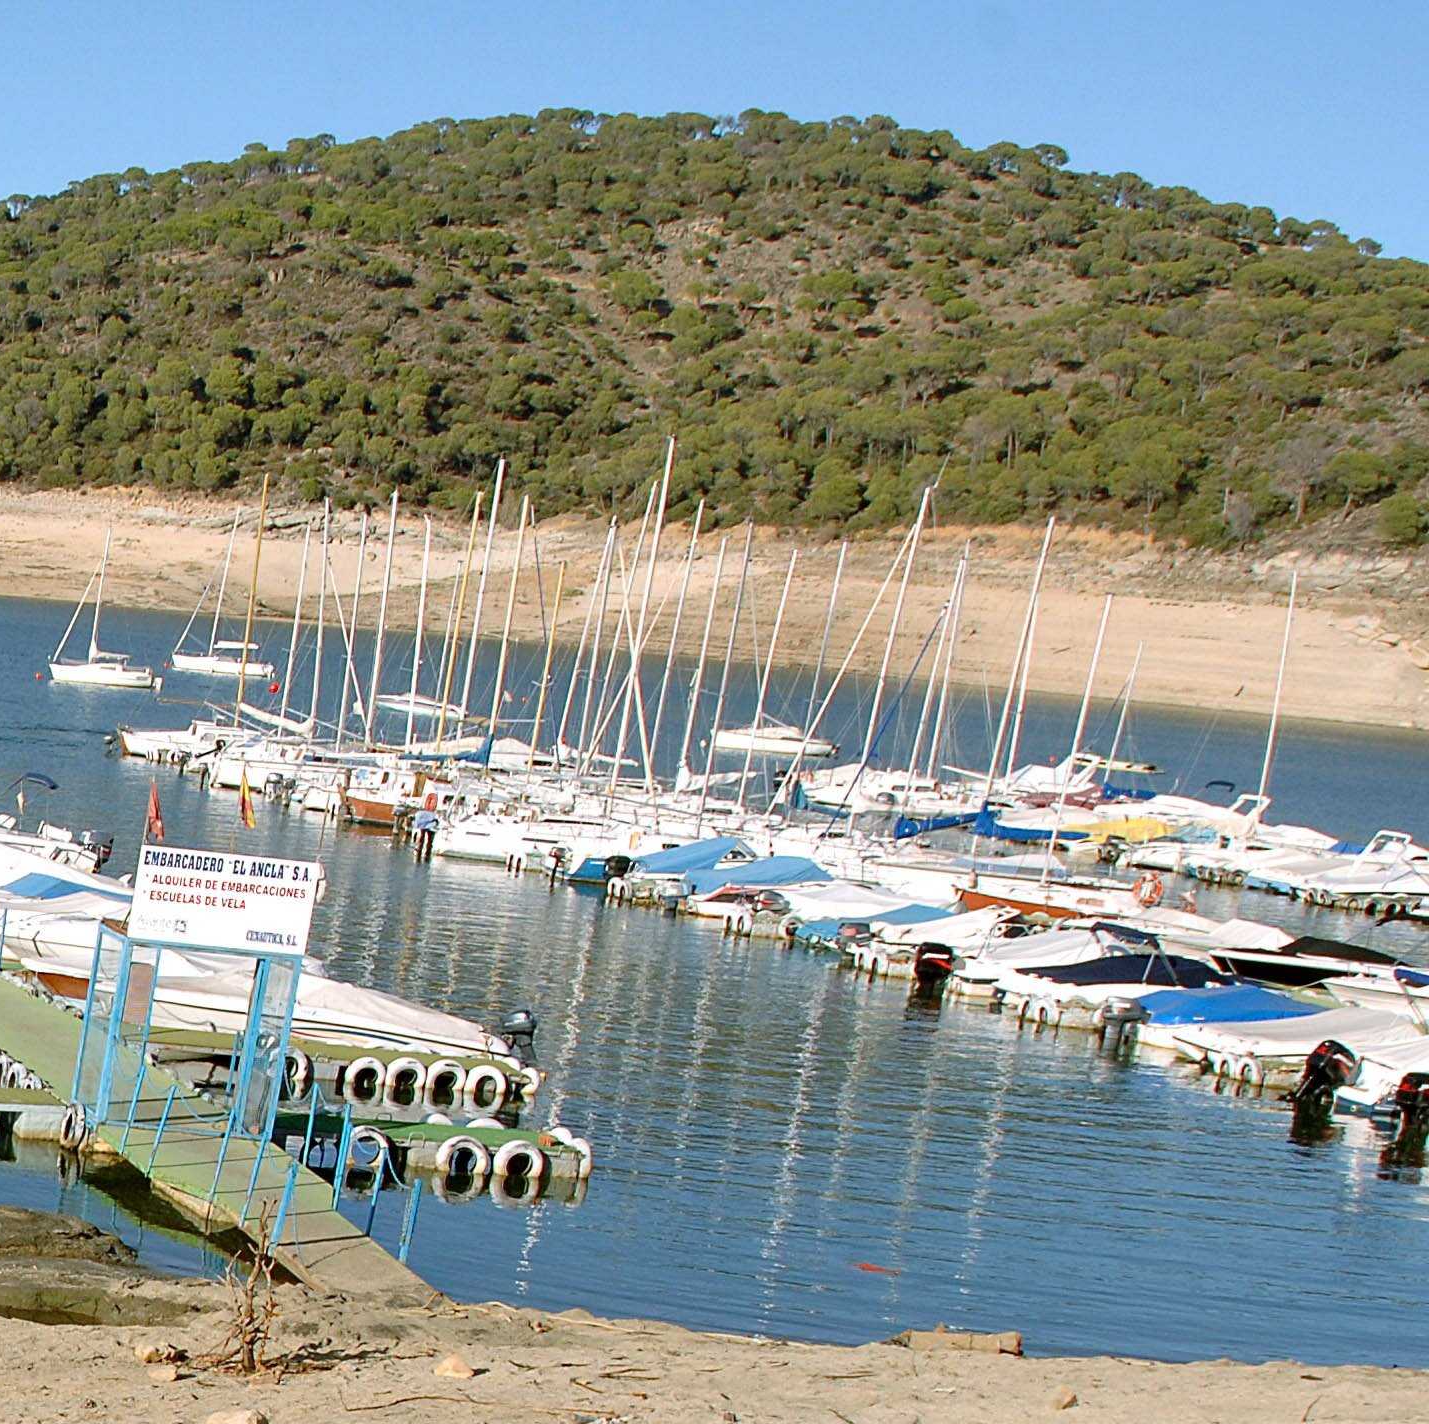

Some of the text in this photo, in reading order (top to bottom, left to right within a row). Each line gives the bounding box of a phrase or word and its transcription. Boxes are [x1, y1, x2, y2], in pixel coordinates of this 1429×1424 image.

[144, 850, 224, 873] EMBARCADERO
[292, 865, 312, 882] S.A.
[151, 874, 306, 899] ALQUILER DE EMBARCACIONES
[149, 890, 246, 909] ESCUELAS DE VELA
